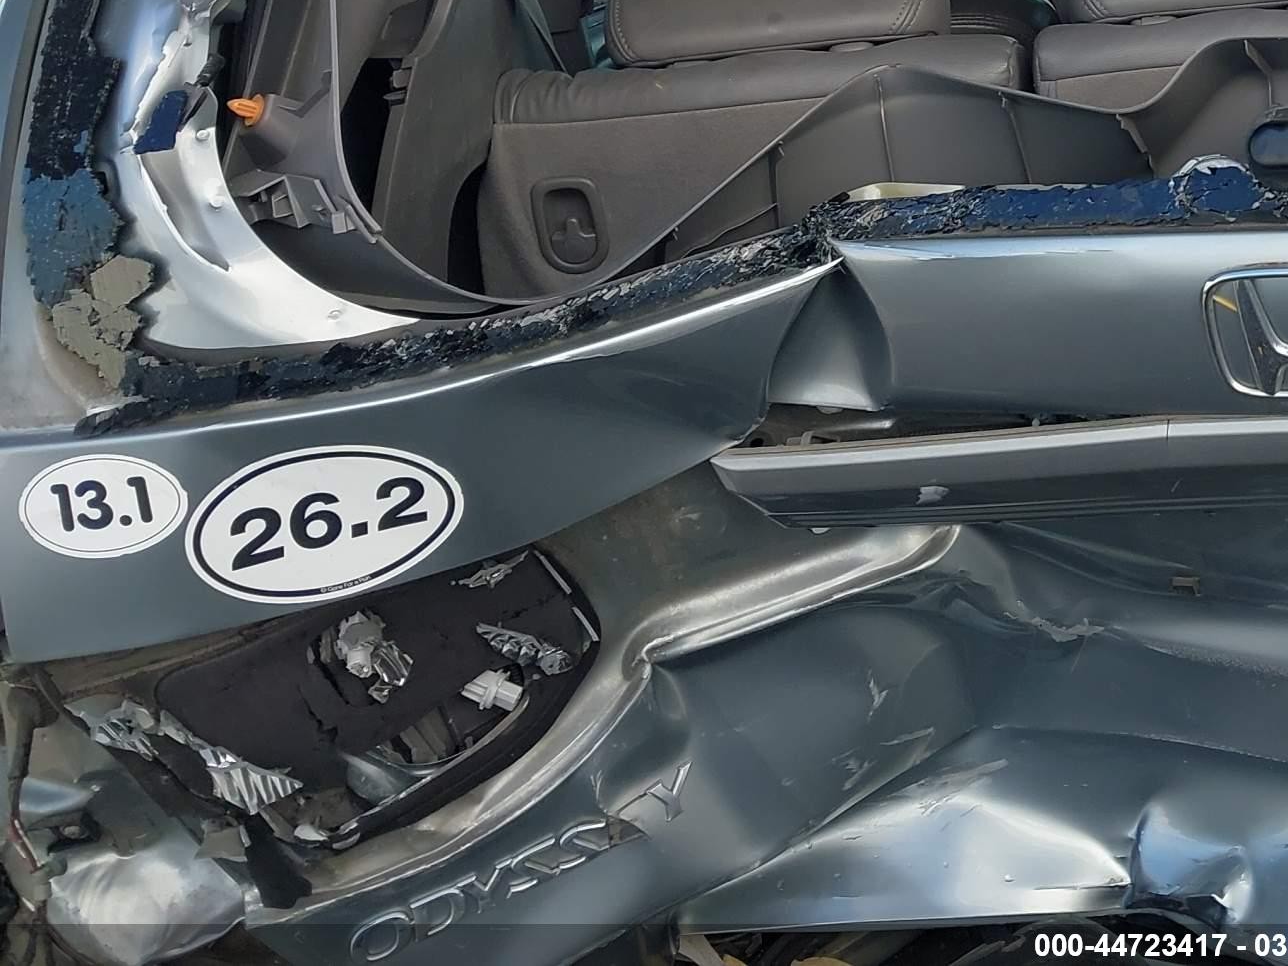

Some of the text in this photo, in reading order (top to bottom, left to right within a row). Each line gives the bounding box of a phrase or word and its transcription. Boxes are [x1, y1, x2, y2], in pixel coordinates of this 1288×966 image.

[50, 476, 154, 532] 13.1
[229, 477, 428, 571] 26.2
[349, 761, 693, 963] ODYSSY
